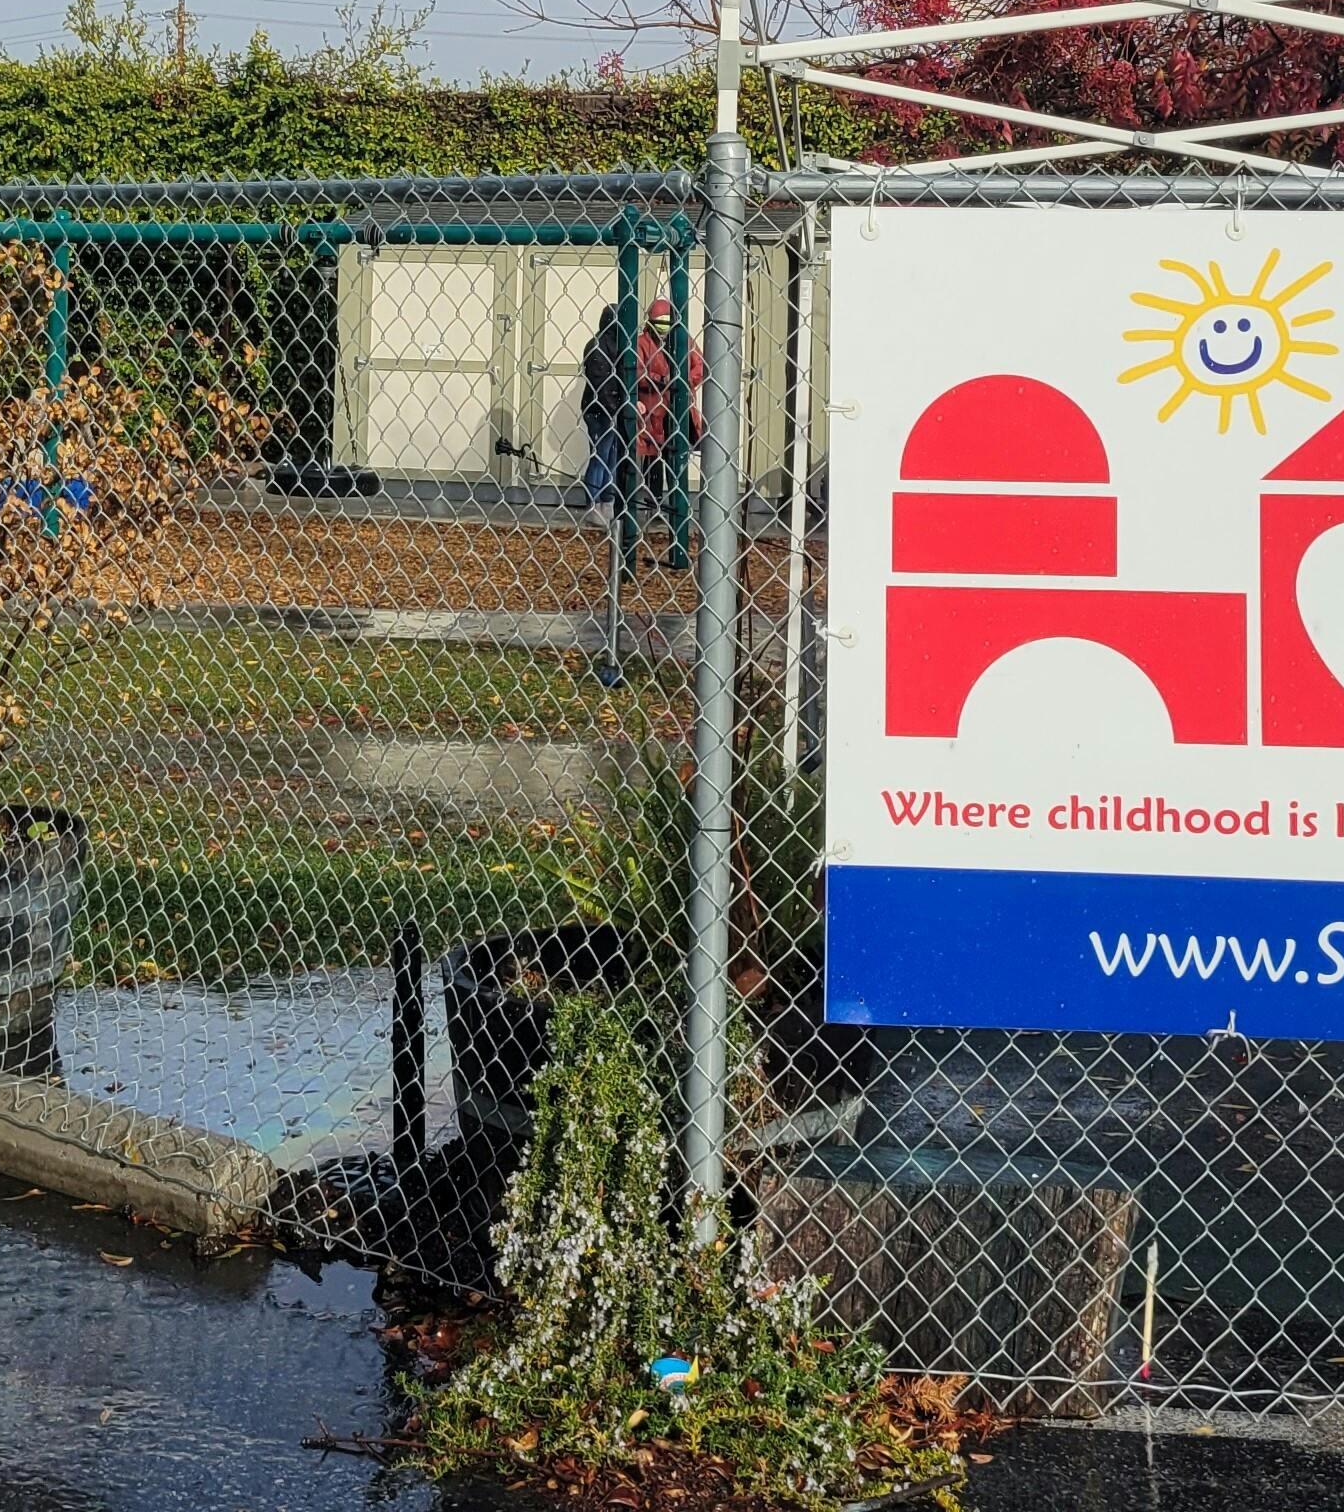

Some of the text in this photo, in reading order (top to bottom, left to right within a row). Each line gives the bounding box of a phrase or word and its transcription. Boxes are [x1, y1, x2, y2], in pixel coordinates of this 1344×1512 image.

[881, 791, 1031, 829] Where
[1047, 794, 1270, 836] childhood
[1289, 802, 1317, 838] is
